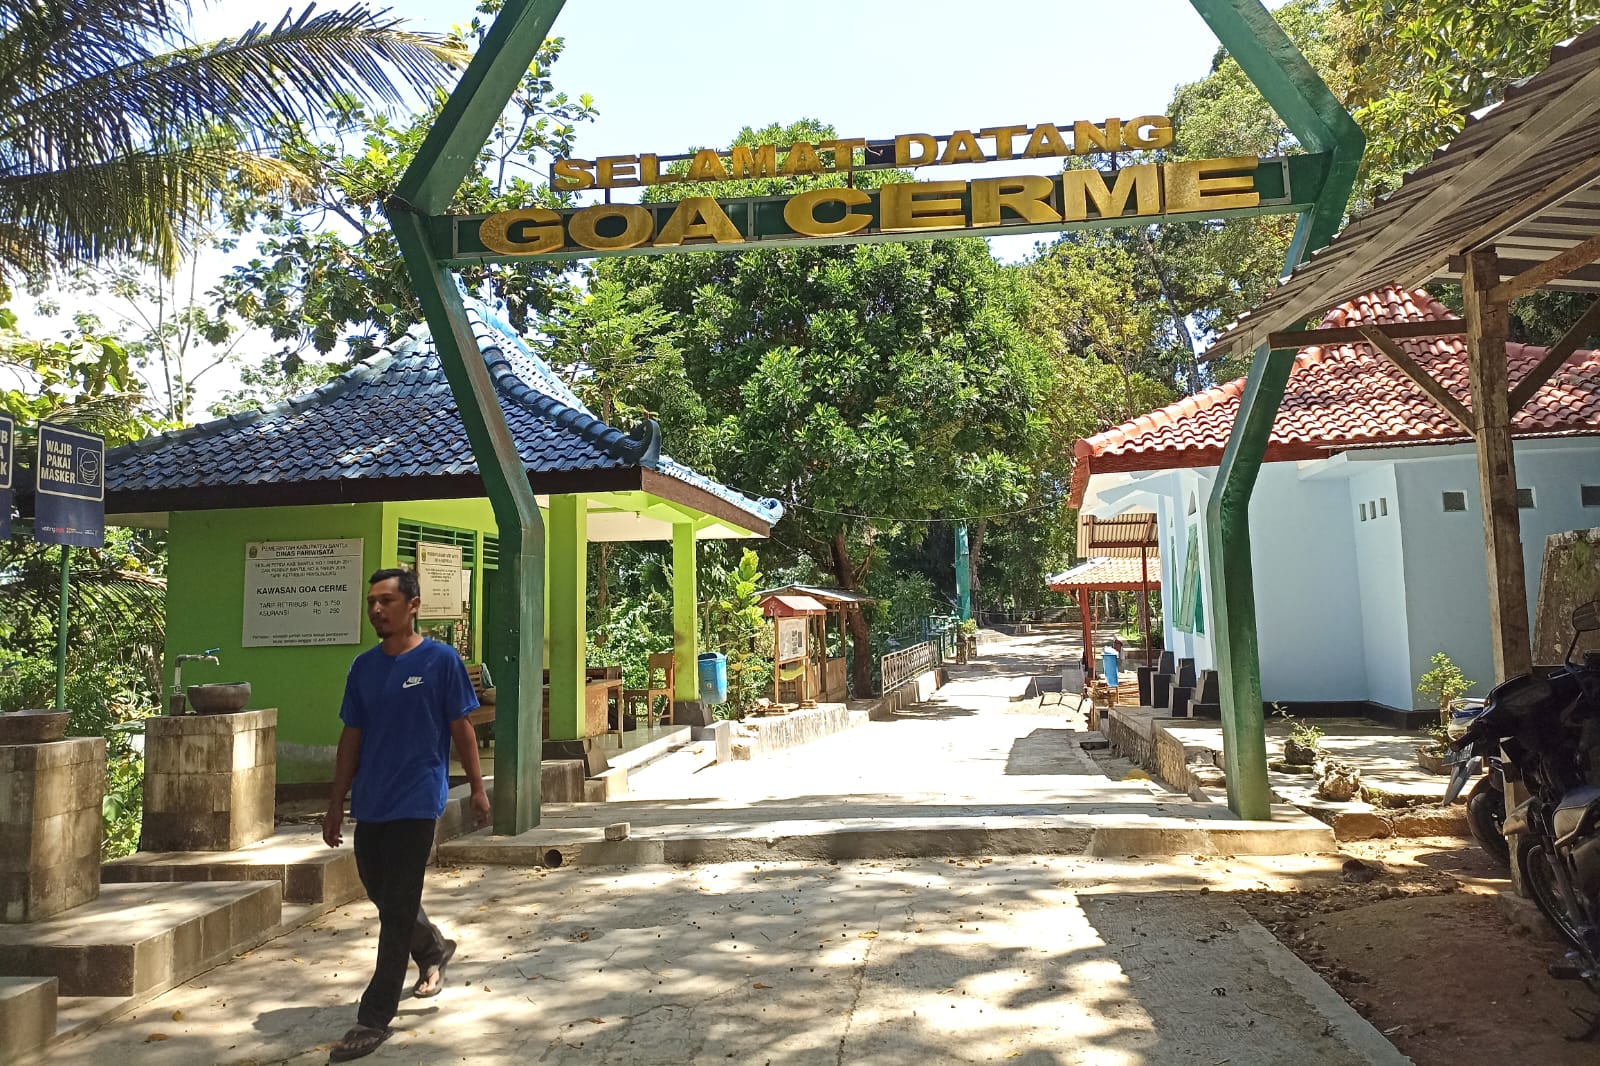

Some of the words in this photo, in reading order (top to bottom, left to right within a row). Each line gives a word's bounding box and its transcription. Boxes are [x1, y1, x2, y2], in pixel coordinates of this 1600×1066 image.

[551, 137, 866, 191] SELAMAT
[895, 114, 1176, 168] DATANG
[479, 196, 745, 256] GOA
[783, 155, 1260, 237] CERME
[46, 440, 72, 456] WAJIB
[46, 453, 71, 470] PAKAI
[40, 467, 76, 484] MASKER
[256, 586, 297, 595] KAWASAN
[298, 585, 317, 593] GOA
[318, 584, 348, 592] CERME
